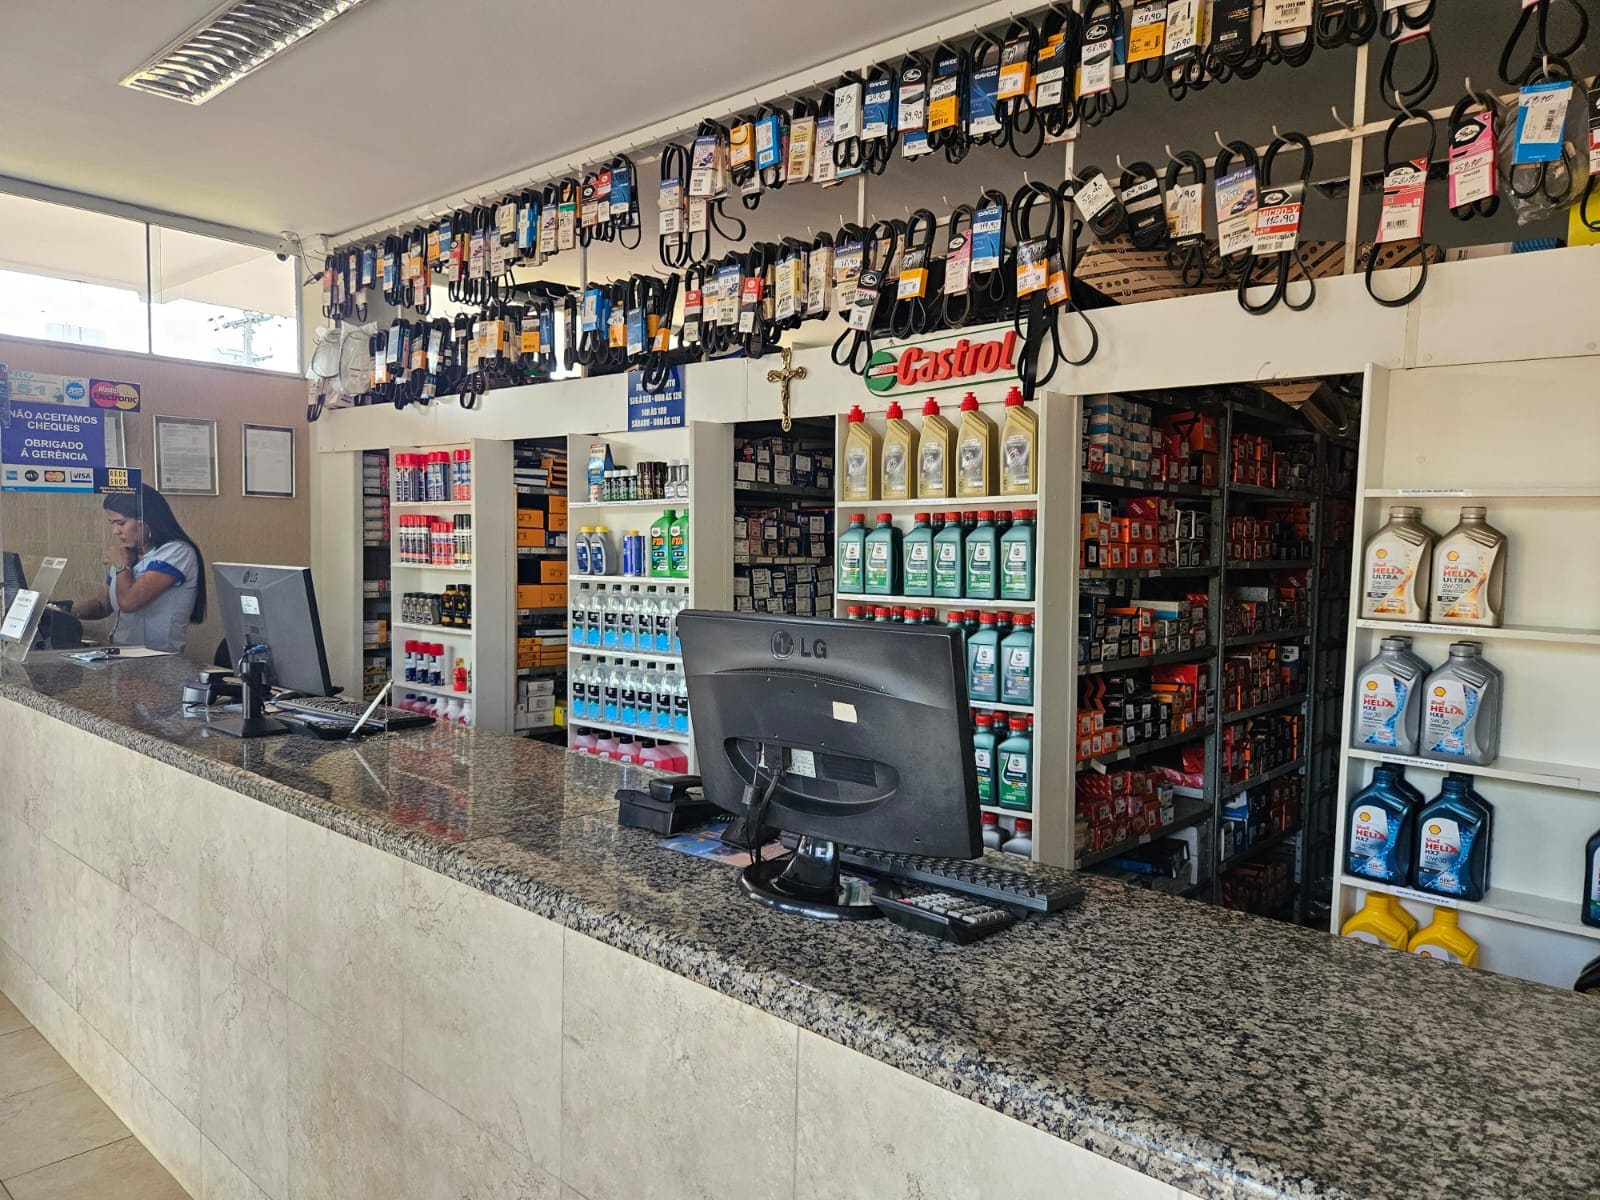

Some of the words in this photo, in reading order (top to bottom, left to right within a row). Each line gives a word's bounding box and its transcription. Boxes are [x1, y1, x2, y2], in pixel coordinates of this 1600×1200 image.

[896, 330, 1017, 386] Castrol
[94, 392, 138, 404] Electronic
[10, 408, 32, 419] NÃO
[35, 412, 98, 424] ACEITAMOS
[28, 421, 80, 432] CHEQUES
[24, 438, 84, 450] OBRIGADO
[32, 450, 88, 461] GERÊNCIA
[73, 471, 91, 479] VISA
[1372, 566, 1404, 575] HELIX
[1443, 569, 1478, 578] HELIX
[800, 638, 827, 659] LG
[1363, 698, 1395, 708] HELIX
[1430, 705, 1464, 715] HELIX
[1356, 829, 1386, 840] HELIX
[1425, 842, 1458, 854] HELIX
